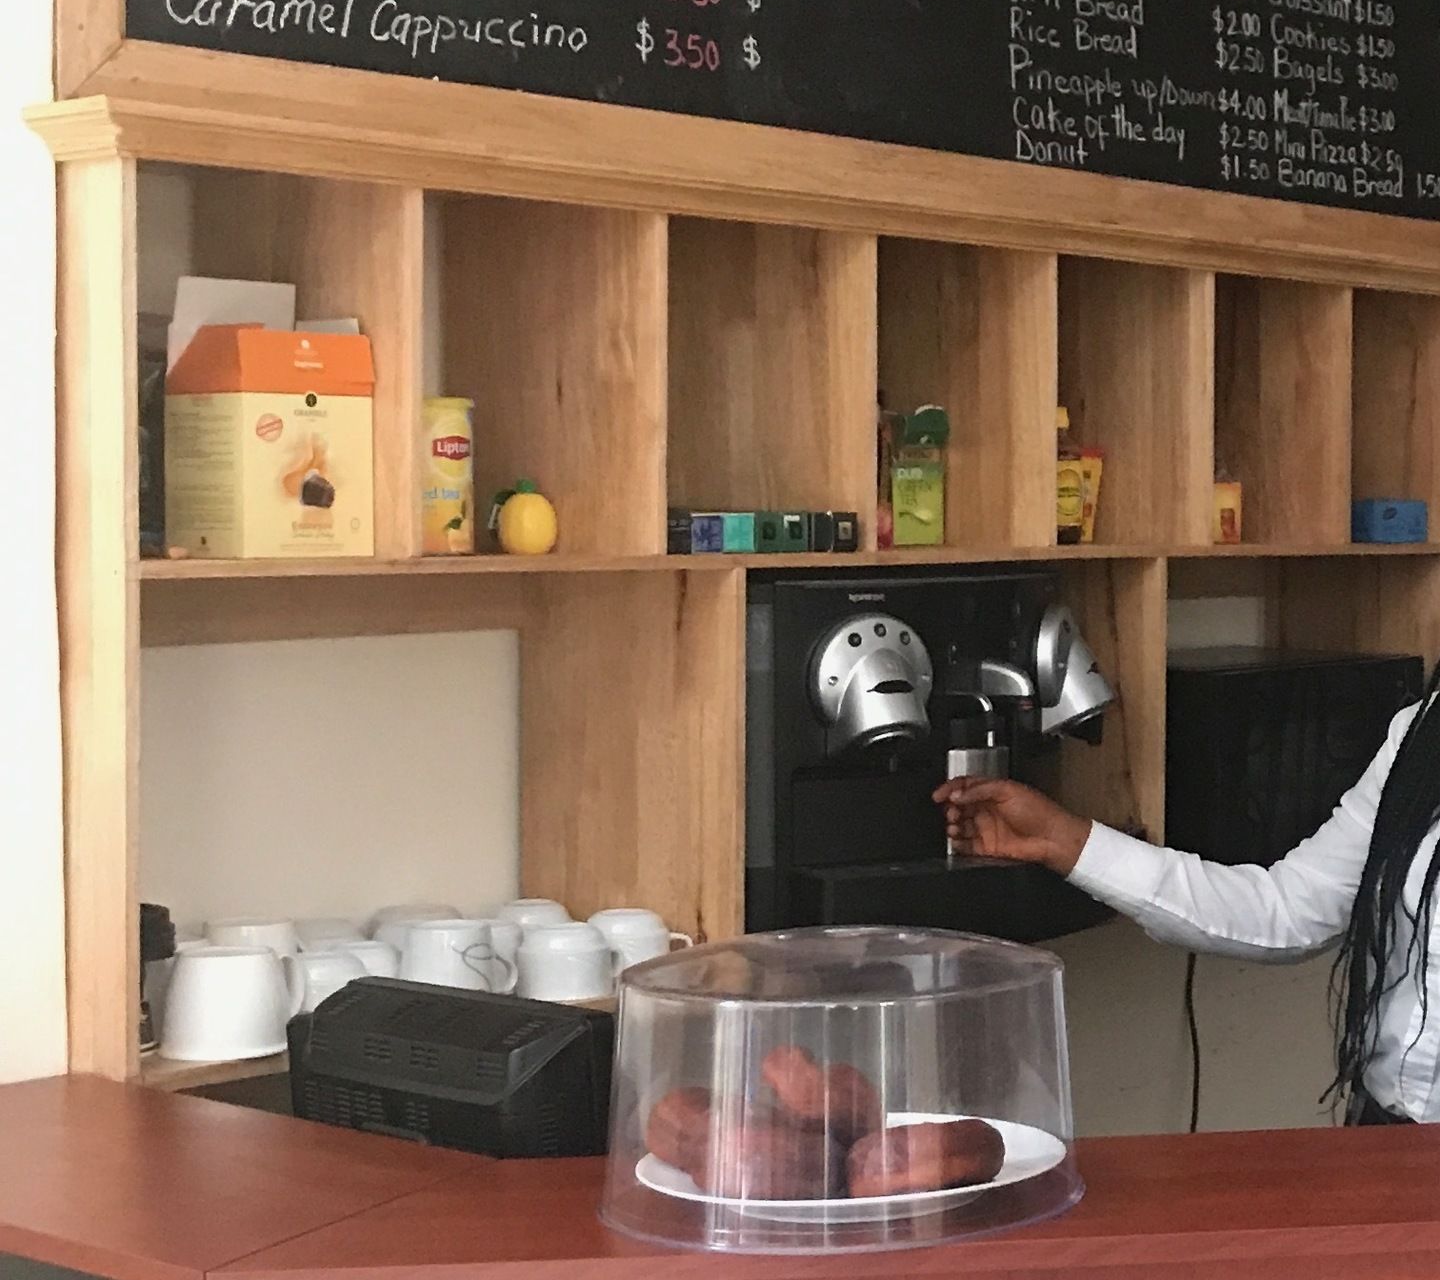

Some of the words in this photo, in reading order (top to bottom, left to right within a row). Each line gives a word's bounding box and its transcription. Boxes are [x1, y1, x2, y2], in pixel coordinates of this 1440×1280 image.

[369, 0, 589, 58] Cappuccino
[1010, 6, 1061, 48] Rice
[1073, 18, 1138, 59] Bread
[1270, 13, 1351, 56] Cookies
[1008, 43, 1122, 107] Pineapple
[1273, 46, 1345, 96] Bagels
[1013, 96, 1078, 136] Cake
[1111, 103, 1147, 142] the
[1152, 111, 1186, 161] day
[1016, 129, 1089, 165] Donut
[1311, 128, 1357, 164] Pizza
[1278, 157, 1347, 193] Banana
[1353, 158, 1404, 198] Bread
